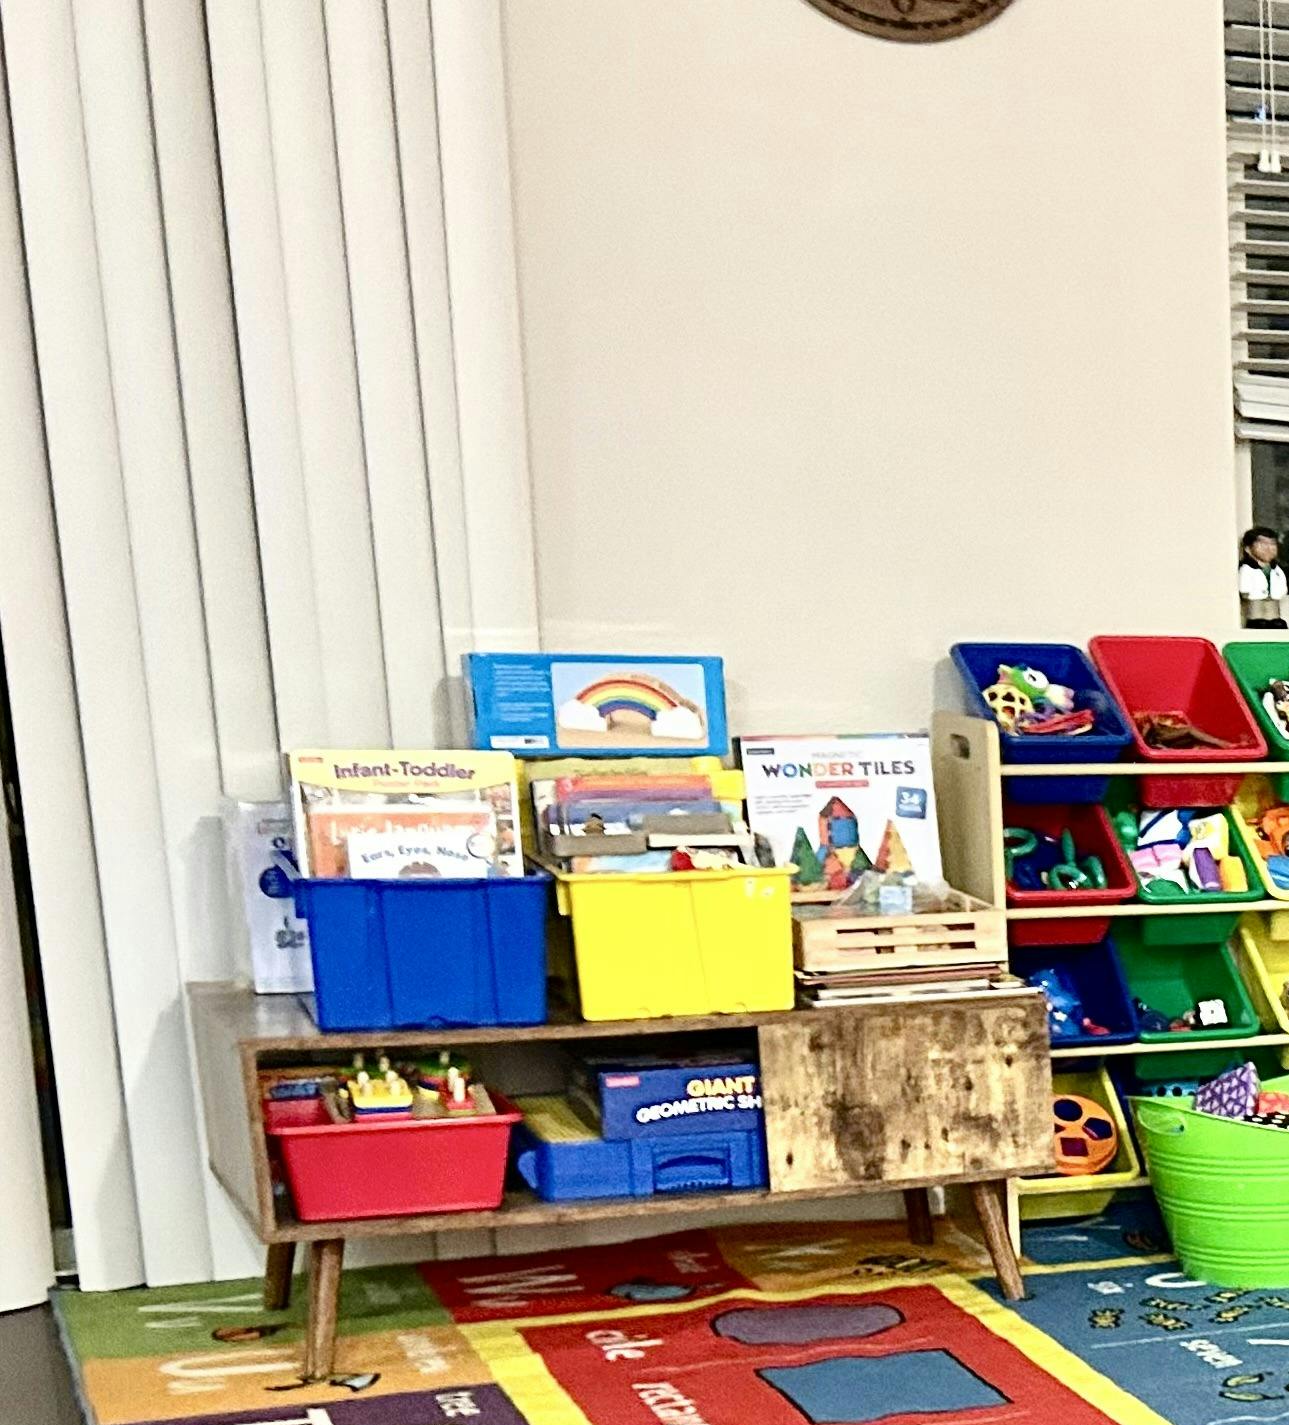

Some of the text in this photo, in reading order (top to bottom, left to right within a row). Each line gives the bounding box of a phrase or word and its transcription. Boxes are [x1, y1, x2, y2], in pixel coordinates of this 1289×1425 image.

[334, 761, 475, 780] Infant-Toddler
[762, 760, 915, 779] WONDER TILES
[687, 1075, 756, 1097] GIANT
[636, 1096, 735, 1124] GEOMETRIC
[434, 1390, 481, 1418] tree
